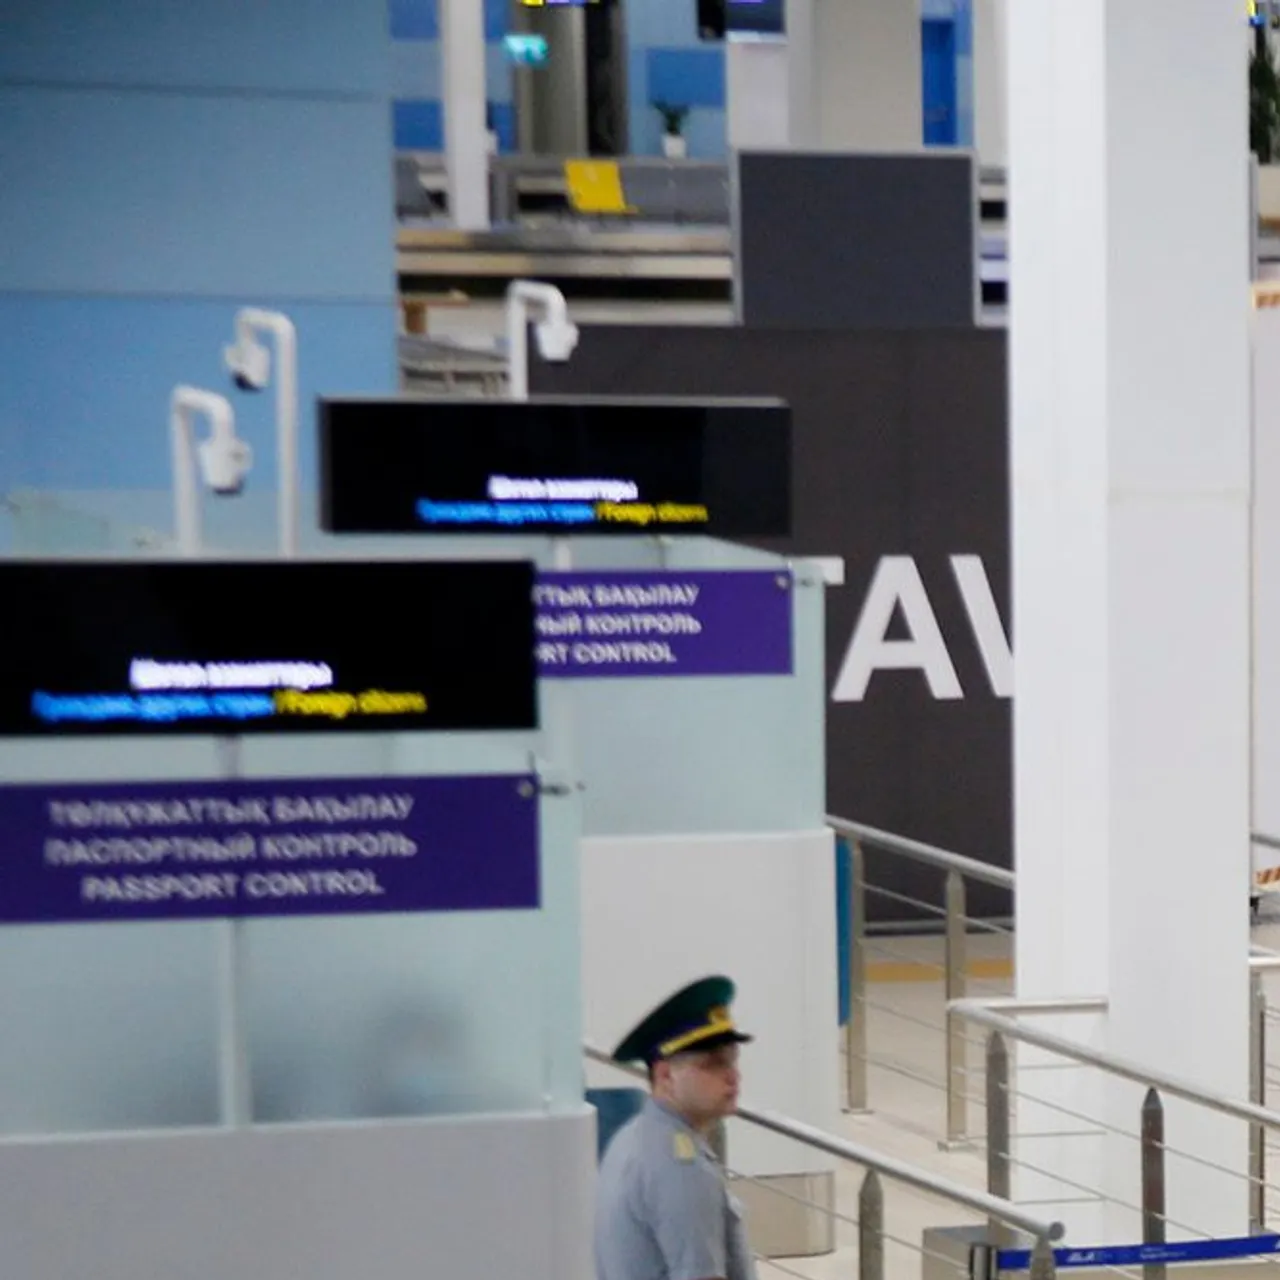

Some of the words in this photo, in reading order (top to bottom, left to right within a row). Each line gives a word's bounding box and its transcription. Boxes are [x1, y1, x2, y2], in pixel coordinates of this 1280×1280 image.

[787, 554, 1013, 701] AV
[574, 642, 676, 664] CONTROL
[44, 831, 256, 866] ПАСПОРТНЫЙ
[260, 830, 418, 862] КОНТРОЛЬ
[81, 871, 240, 902] PASSPORT
[243, 868, 385, 897] CONTROL
